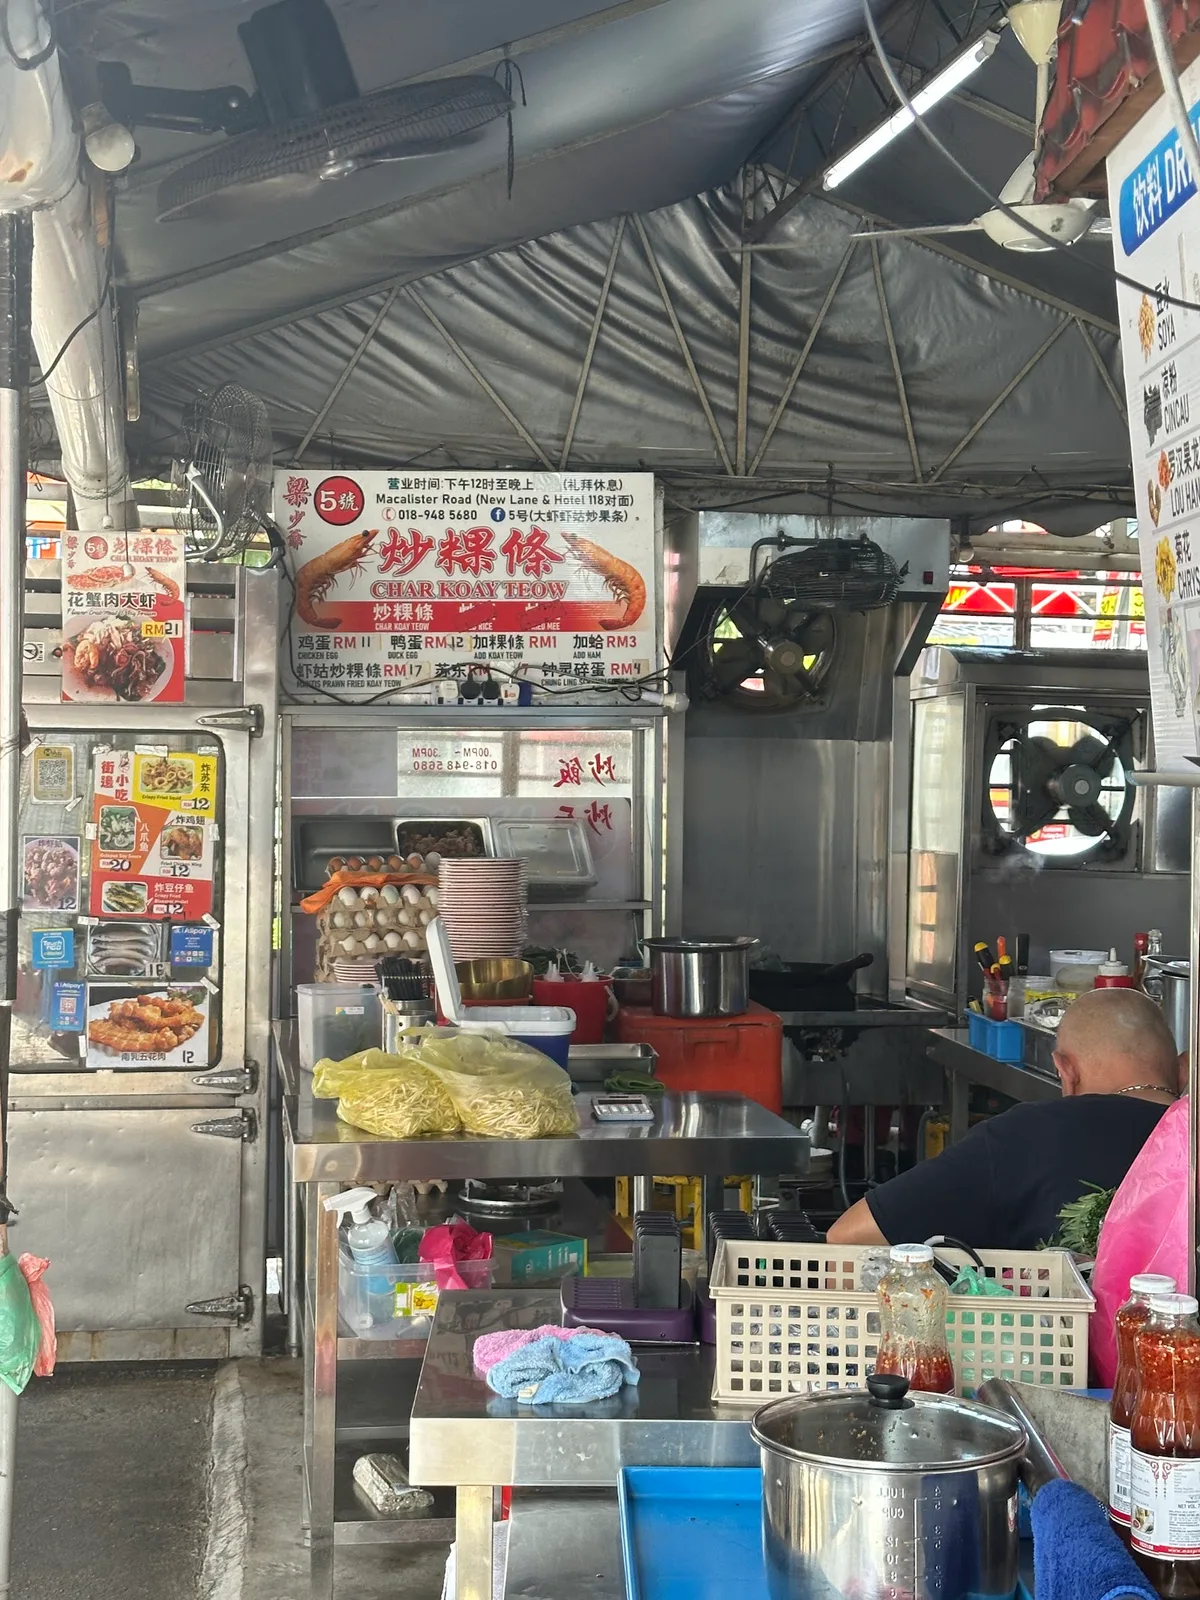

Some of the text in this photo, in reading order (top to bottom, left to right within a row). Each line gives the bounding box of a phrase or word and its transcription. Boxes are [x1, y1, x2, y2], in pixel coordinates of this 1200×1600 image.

[1133, 154, 1162, 238] 饮料
[1157, 313, 1177, 351] SOYA
[1163, 393, 1190, 435] CINCAU
[563, 478, 623, 491] (礼拜休息)
[376, 493, 439, 505] Macalister
[442, 494, 472, 505] Road
[475, 494, 506, 506] (New
[510, 495, 538, 505] Lane
[542, 495, 551, 505] &
[554, 495, 585, 505] Hotel
[1170, 485, 1185, 517] LOU
[398, 509, 478, 520] 018-948 5680
[377, 524, 566, 579] 炒粿條
[1174, 530, 1192, 564] 菊花
[370, 580, 568, 600] CHAR KOAY TEOW
[67, 591, 157, 608] 花蟹肉大虾
[373, 603, 434, 622] 炒粿條
[375, 622, 430, 631] CHAR KOAY TEOW
[478, 622, 493, 631] RICE
[547, 622, 561, 631] MEE
[298, 635, 331, 651] 鸡蛋
[390, 635, 423, 651] 鸭蛋
[473, 634, 557, 650] 加粿條 RM1
[607, 635, 637, 648] RM3
[298, 652, 338, 660] CHICKEN EGG
[388, 652, 418, 660] DUCK EGG
[474, 652, 523, 660] ADD KOAY TEOW
[573, 652, 601, 660] ADD HAM
[435, 662, 467, 678] 苏东
[541, 662, 606, 678] 钟灵碎蛋
[323, 680, 345, 688] PRAWN
[347, 680, 365, 688] FRIED
[366, 680, 383, 688] KOAY
[384, 680, 402, 688] TEOW
[541, 679, 561, 687] CHUNG
[563, 679, 578, 687] LING
[200, 763, 212, 792] 炸苏东
[115, 774, 129, 801] 小吃
[191, 797, 210, 810] 12
[110, 859, 131, 872] 20
[171, 865, 190, 877] 12
[57, 898, 77, 910] 12
[182, 1050, 194, 1064] 12
